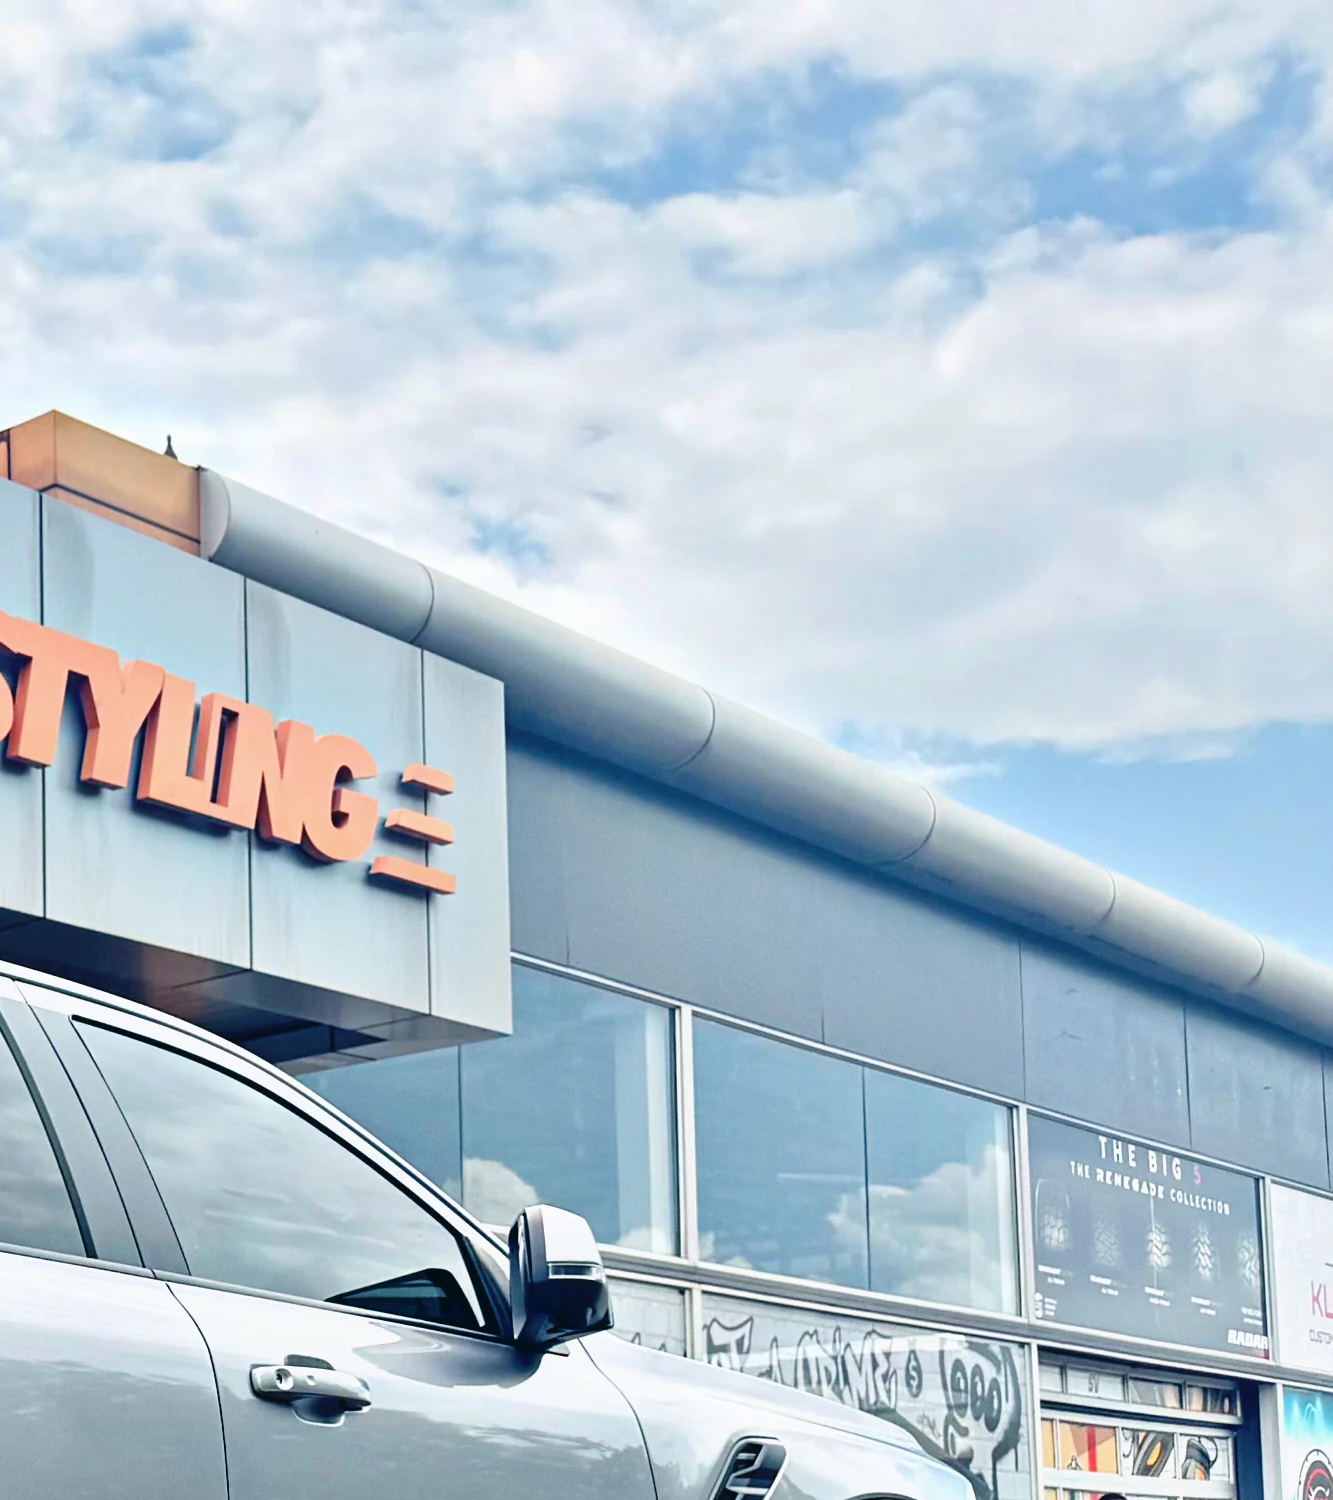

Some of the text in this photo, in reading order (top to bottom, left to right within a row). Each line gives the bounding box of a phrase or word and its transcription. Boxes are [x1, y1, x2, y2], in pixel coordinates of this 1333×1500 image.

[1098, 1135, 1202, 1186] THE BIG 5
[1070, 1160, 1230, 1216] THE RENEGADE COLLECTION
